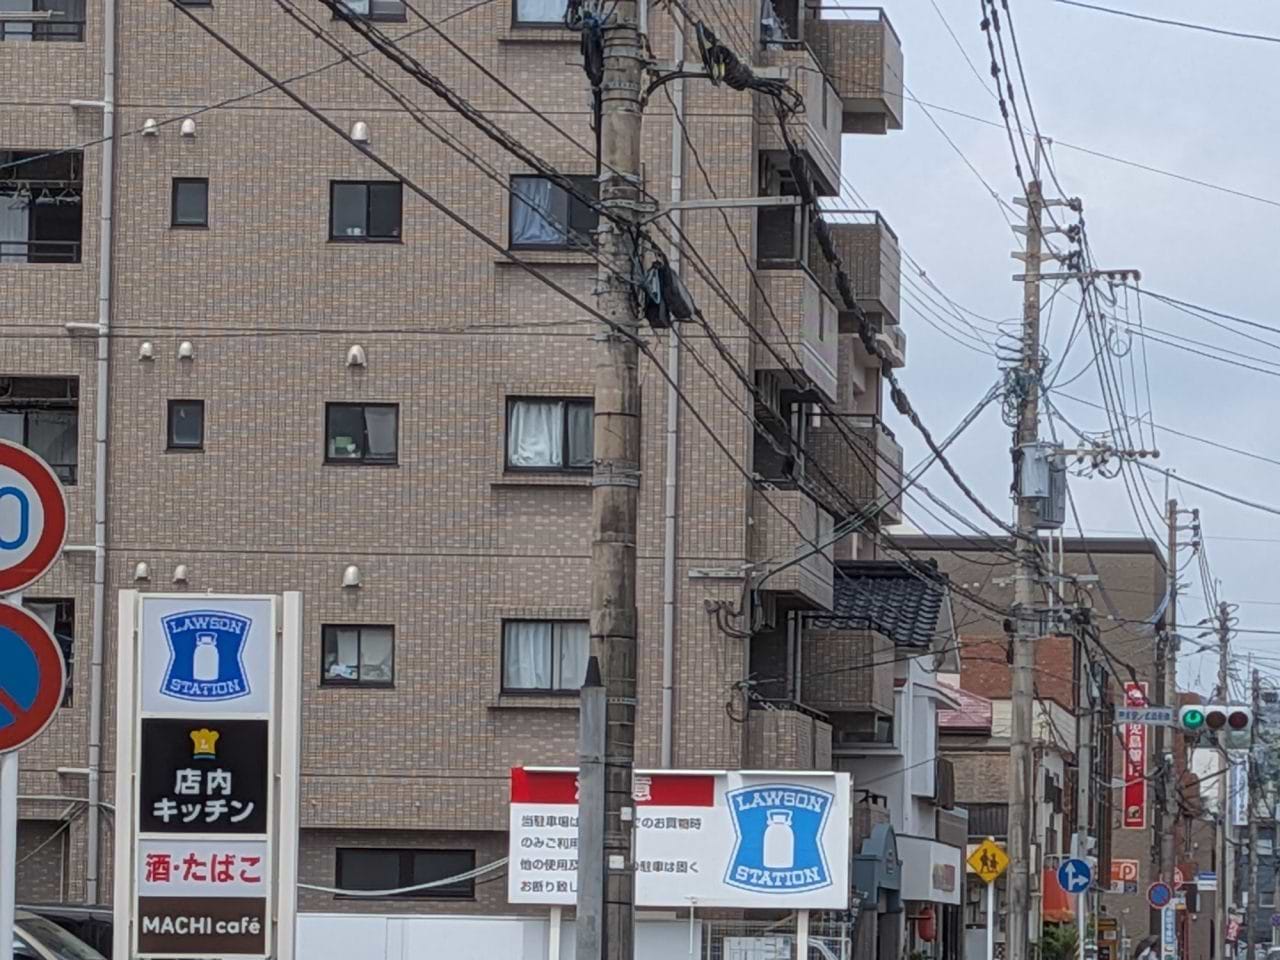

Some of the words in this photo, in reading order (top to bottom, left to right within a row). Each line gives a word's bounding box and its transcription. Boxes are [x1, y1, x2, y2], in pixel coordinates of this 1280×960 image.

[170, 617, 242, 634] LAWSON
[170, 679, 241, 695] STATION
[174, 768, 232, 795] 店内
[153, 798, 254, 823] キッチン
[736, 791, 824, 813] LAWSON
[145, 853, 262, 883] 酒・たばこ
[735, 865, 821, 886] STATION
[142, 916, 212, 934] MACHI
[215, 916, 261, 934] café
